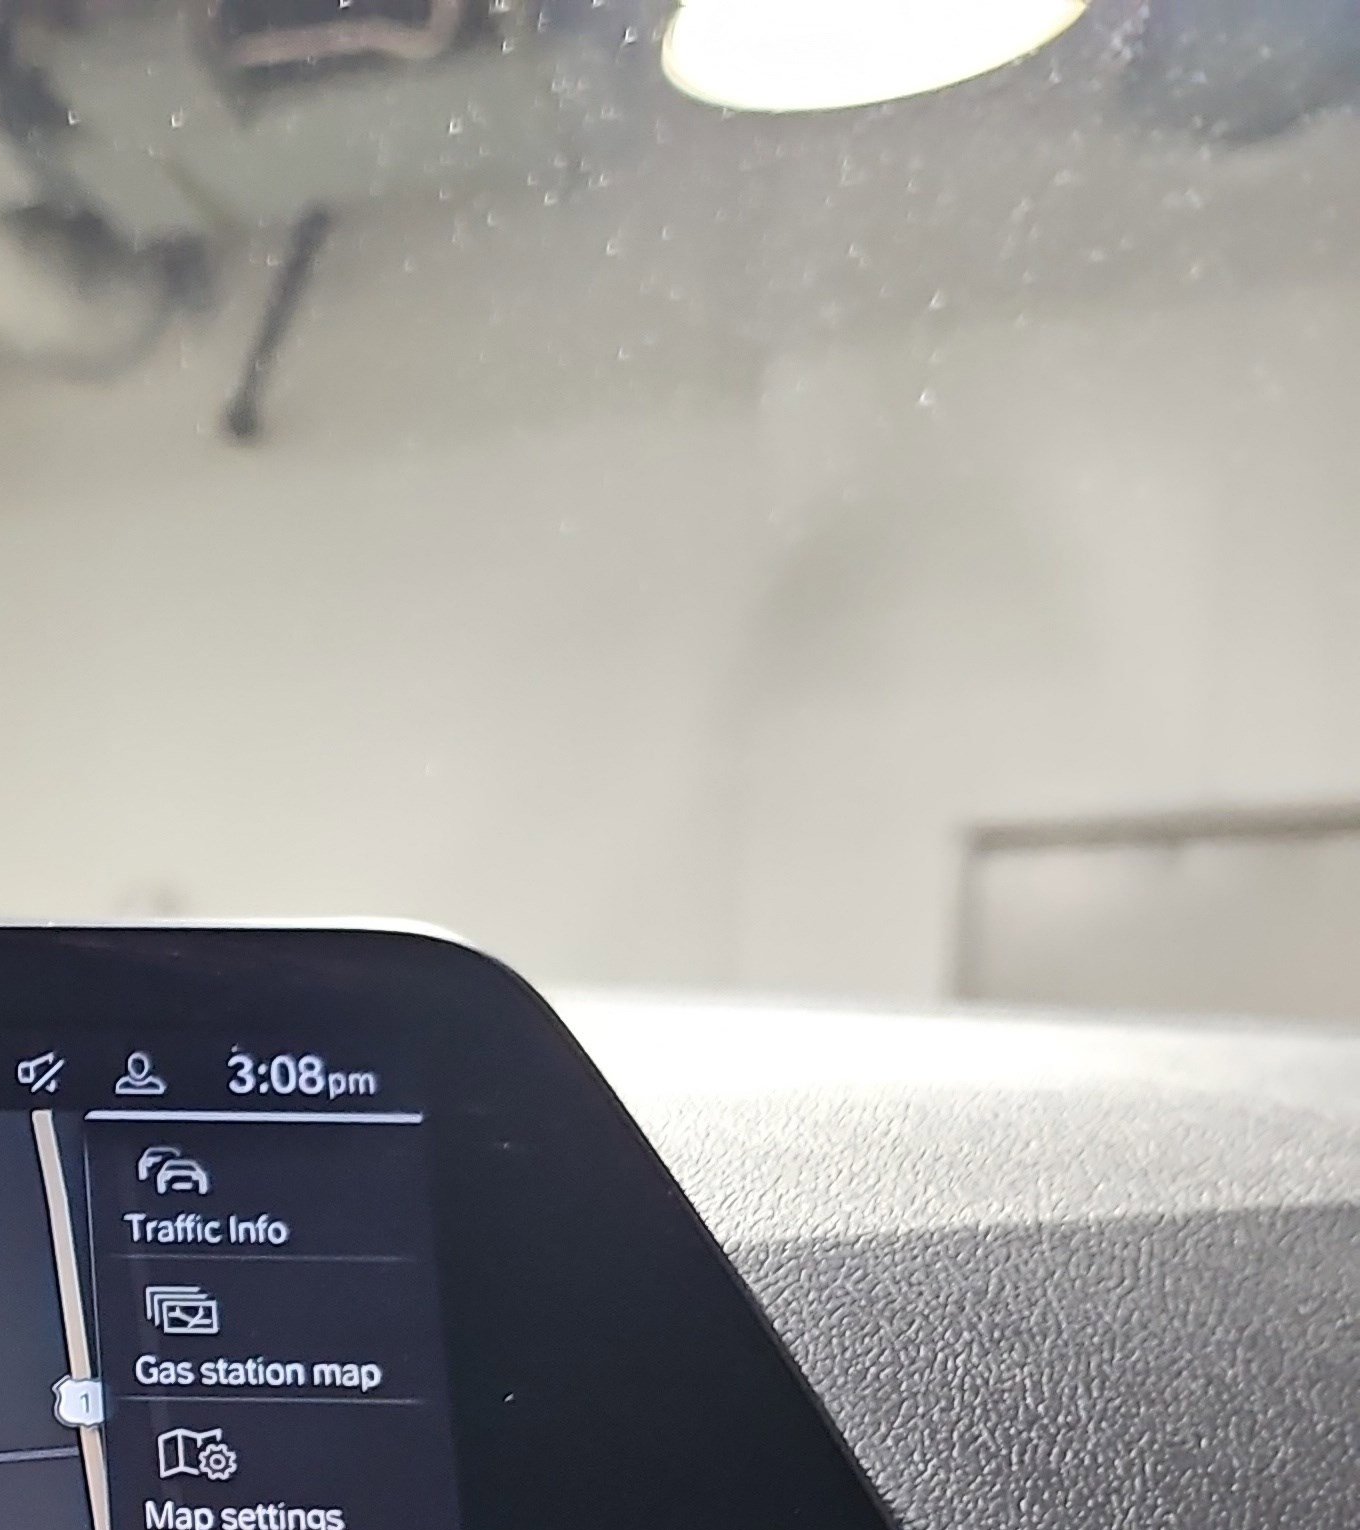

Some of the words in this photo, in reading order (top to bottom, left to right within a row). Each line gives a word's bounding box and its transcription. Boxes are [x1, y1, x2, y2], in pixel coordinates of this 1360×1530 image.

[226, 1054, 376, 1099] 3:08pm
[125, 1213, 222, 1245] Traffic
[230, 1216, 289, 1245] Info
[135, 1354, 192, 1385] Gas
[200, 1355, 306, 1386] station
[312, 1361, 382, 1393] map
[78, 1392, 91, 1414] 1
